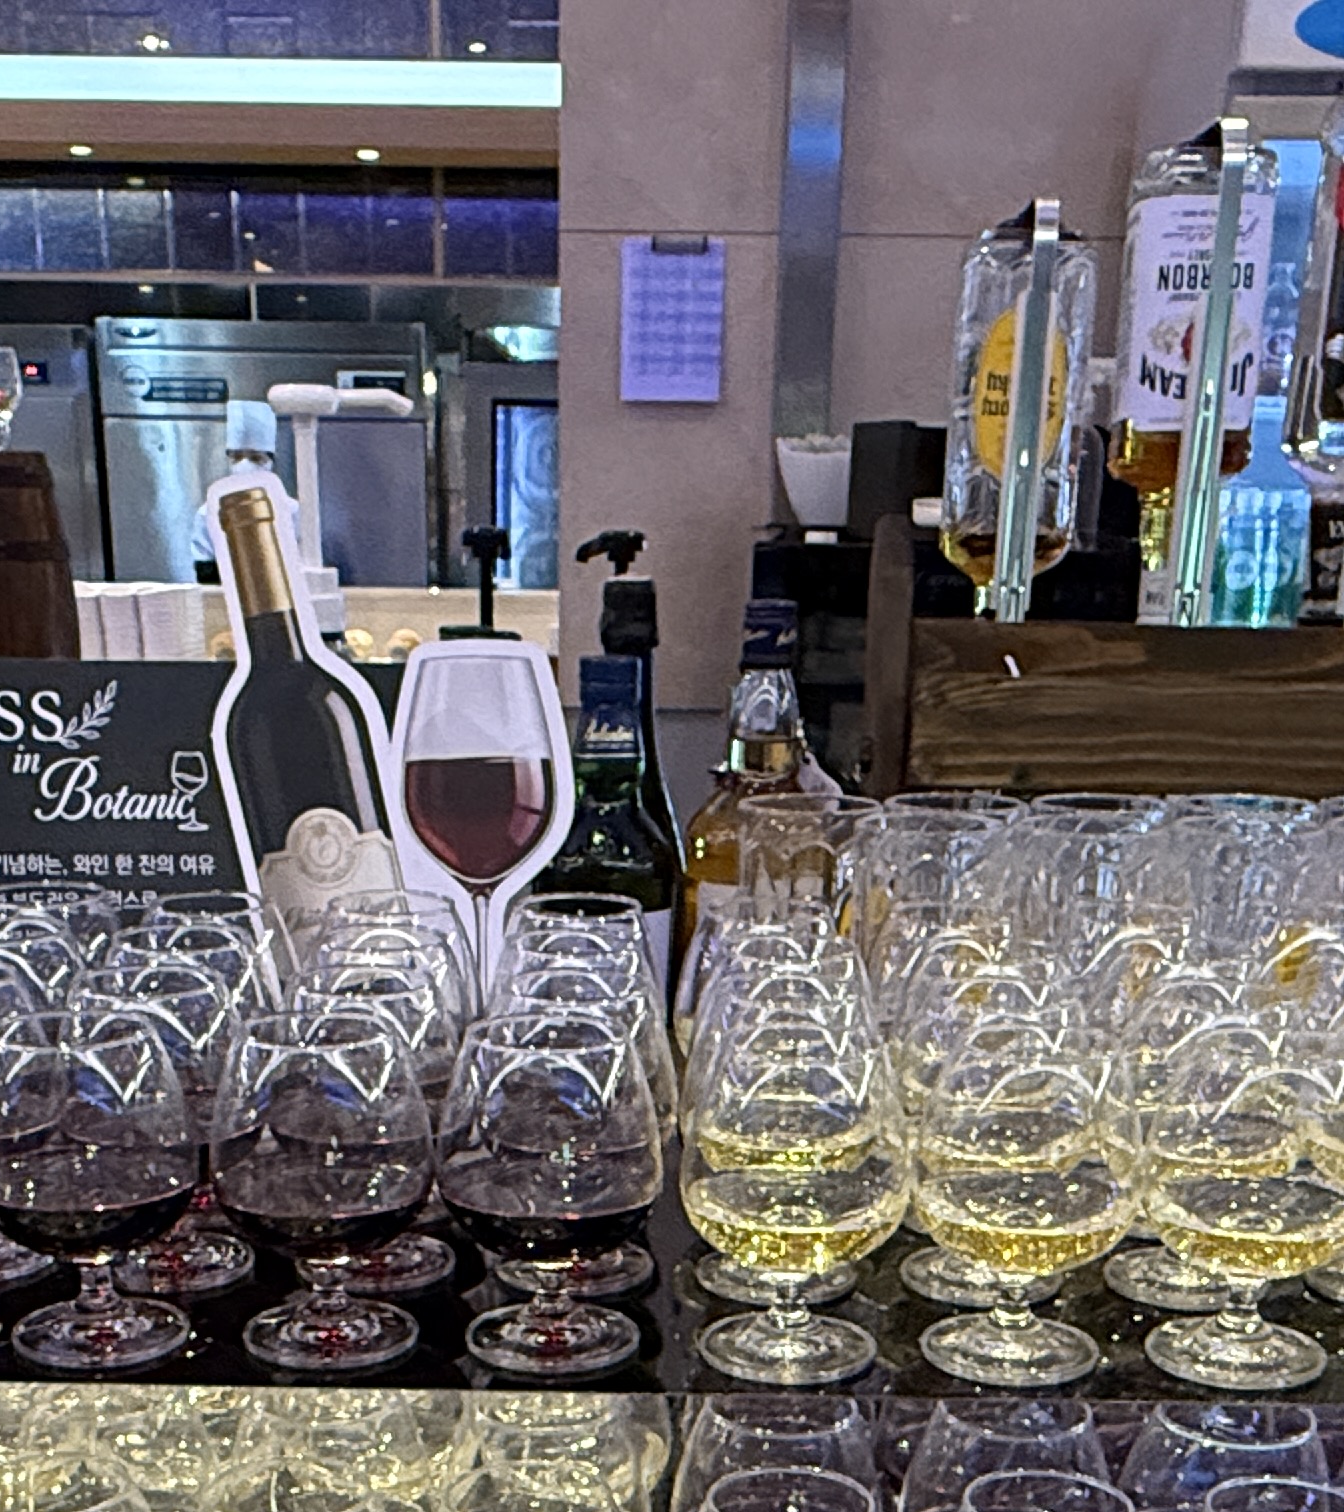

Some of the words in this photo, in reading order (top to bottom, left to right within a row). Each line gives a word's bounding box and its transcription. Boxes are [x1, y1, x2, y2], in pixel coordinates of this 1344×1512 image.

[12, 744, 42, 774] in
[34, 756, 196, 822] Botanic
[73, 854, 109, 876] 와인
[114, 854, 134, 877] 한
[138, 854, 174, 877] 잔의
[179, 854, 216, 877] 여유
